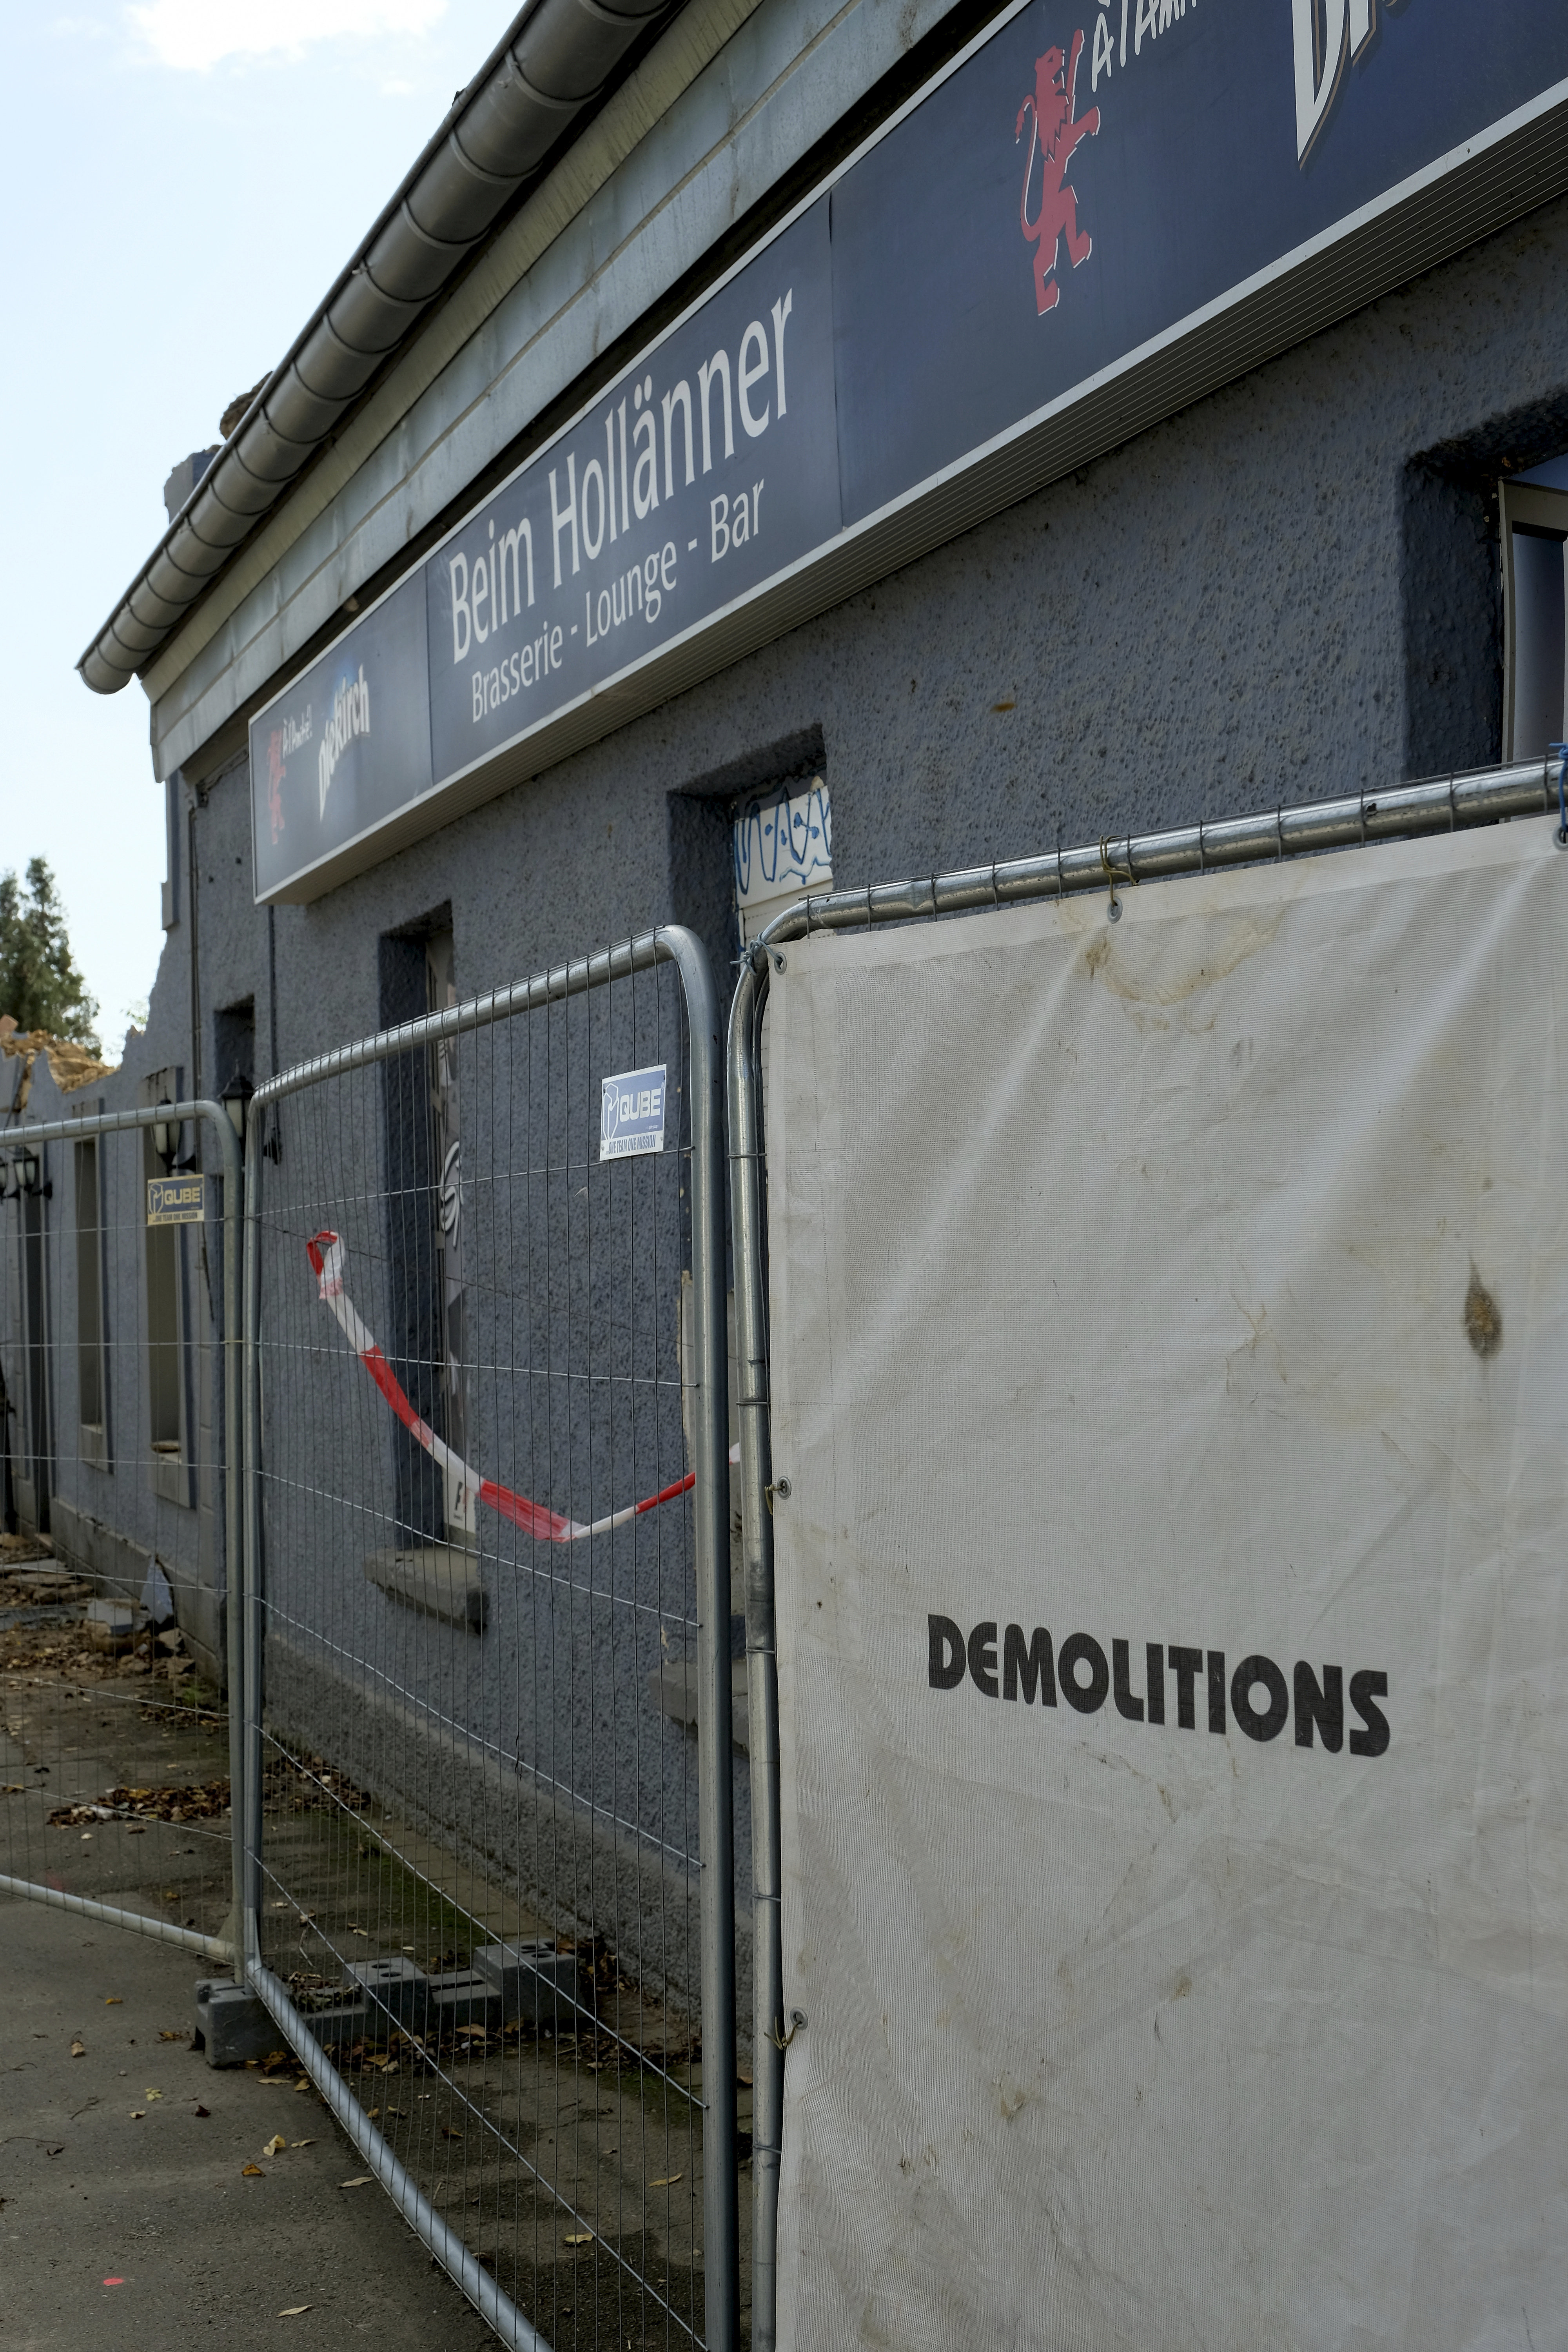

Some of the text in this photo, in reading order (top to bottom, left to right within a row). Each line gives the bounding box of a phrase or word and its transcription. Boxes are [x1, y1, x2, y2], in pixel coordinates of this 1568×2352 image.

[449, 288, 793, 664] Beim Hollänner
[472, 621, 563, 723] Brasserie
[586, 541, 677, 648] Lounge
[710, 479, 764, 563] Bar
[617, 1139, 627, 1153] TEAM
[628, 1138, 636, 1151] ONE
[637, 1134, 656, 1150] MISSION
[620, 1088, 661, 1122] QUBE
[164, 1187, 200, 1205] QUBE
[927, 1614, 1390, 1758] DEMOLITIONS
